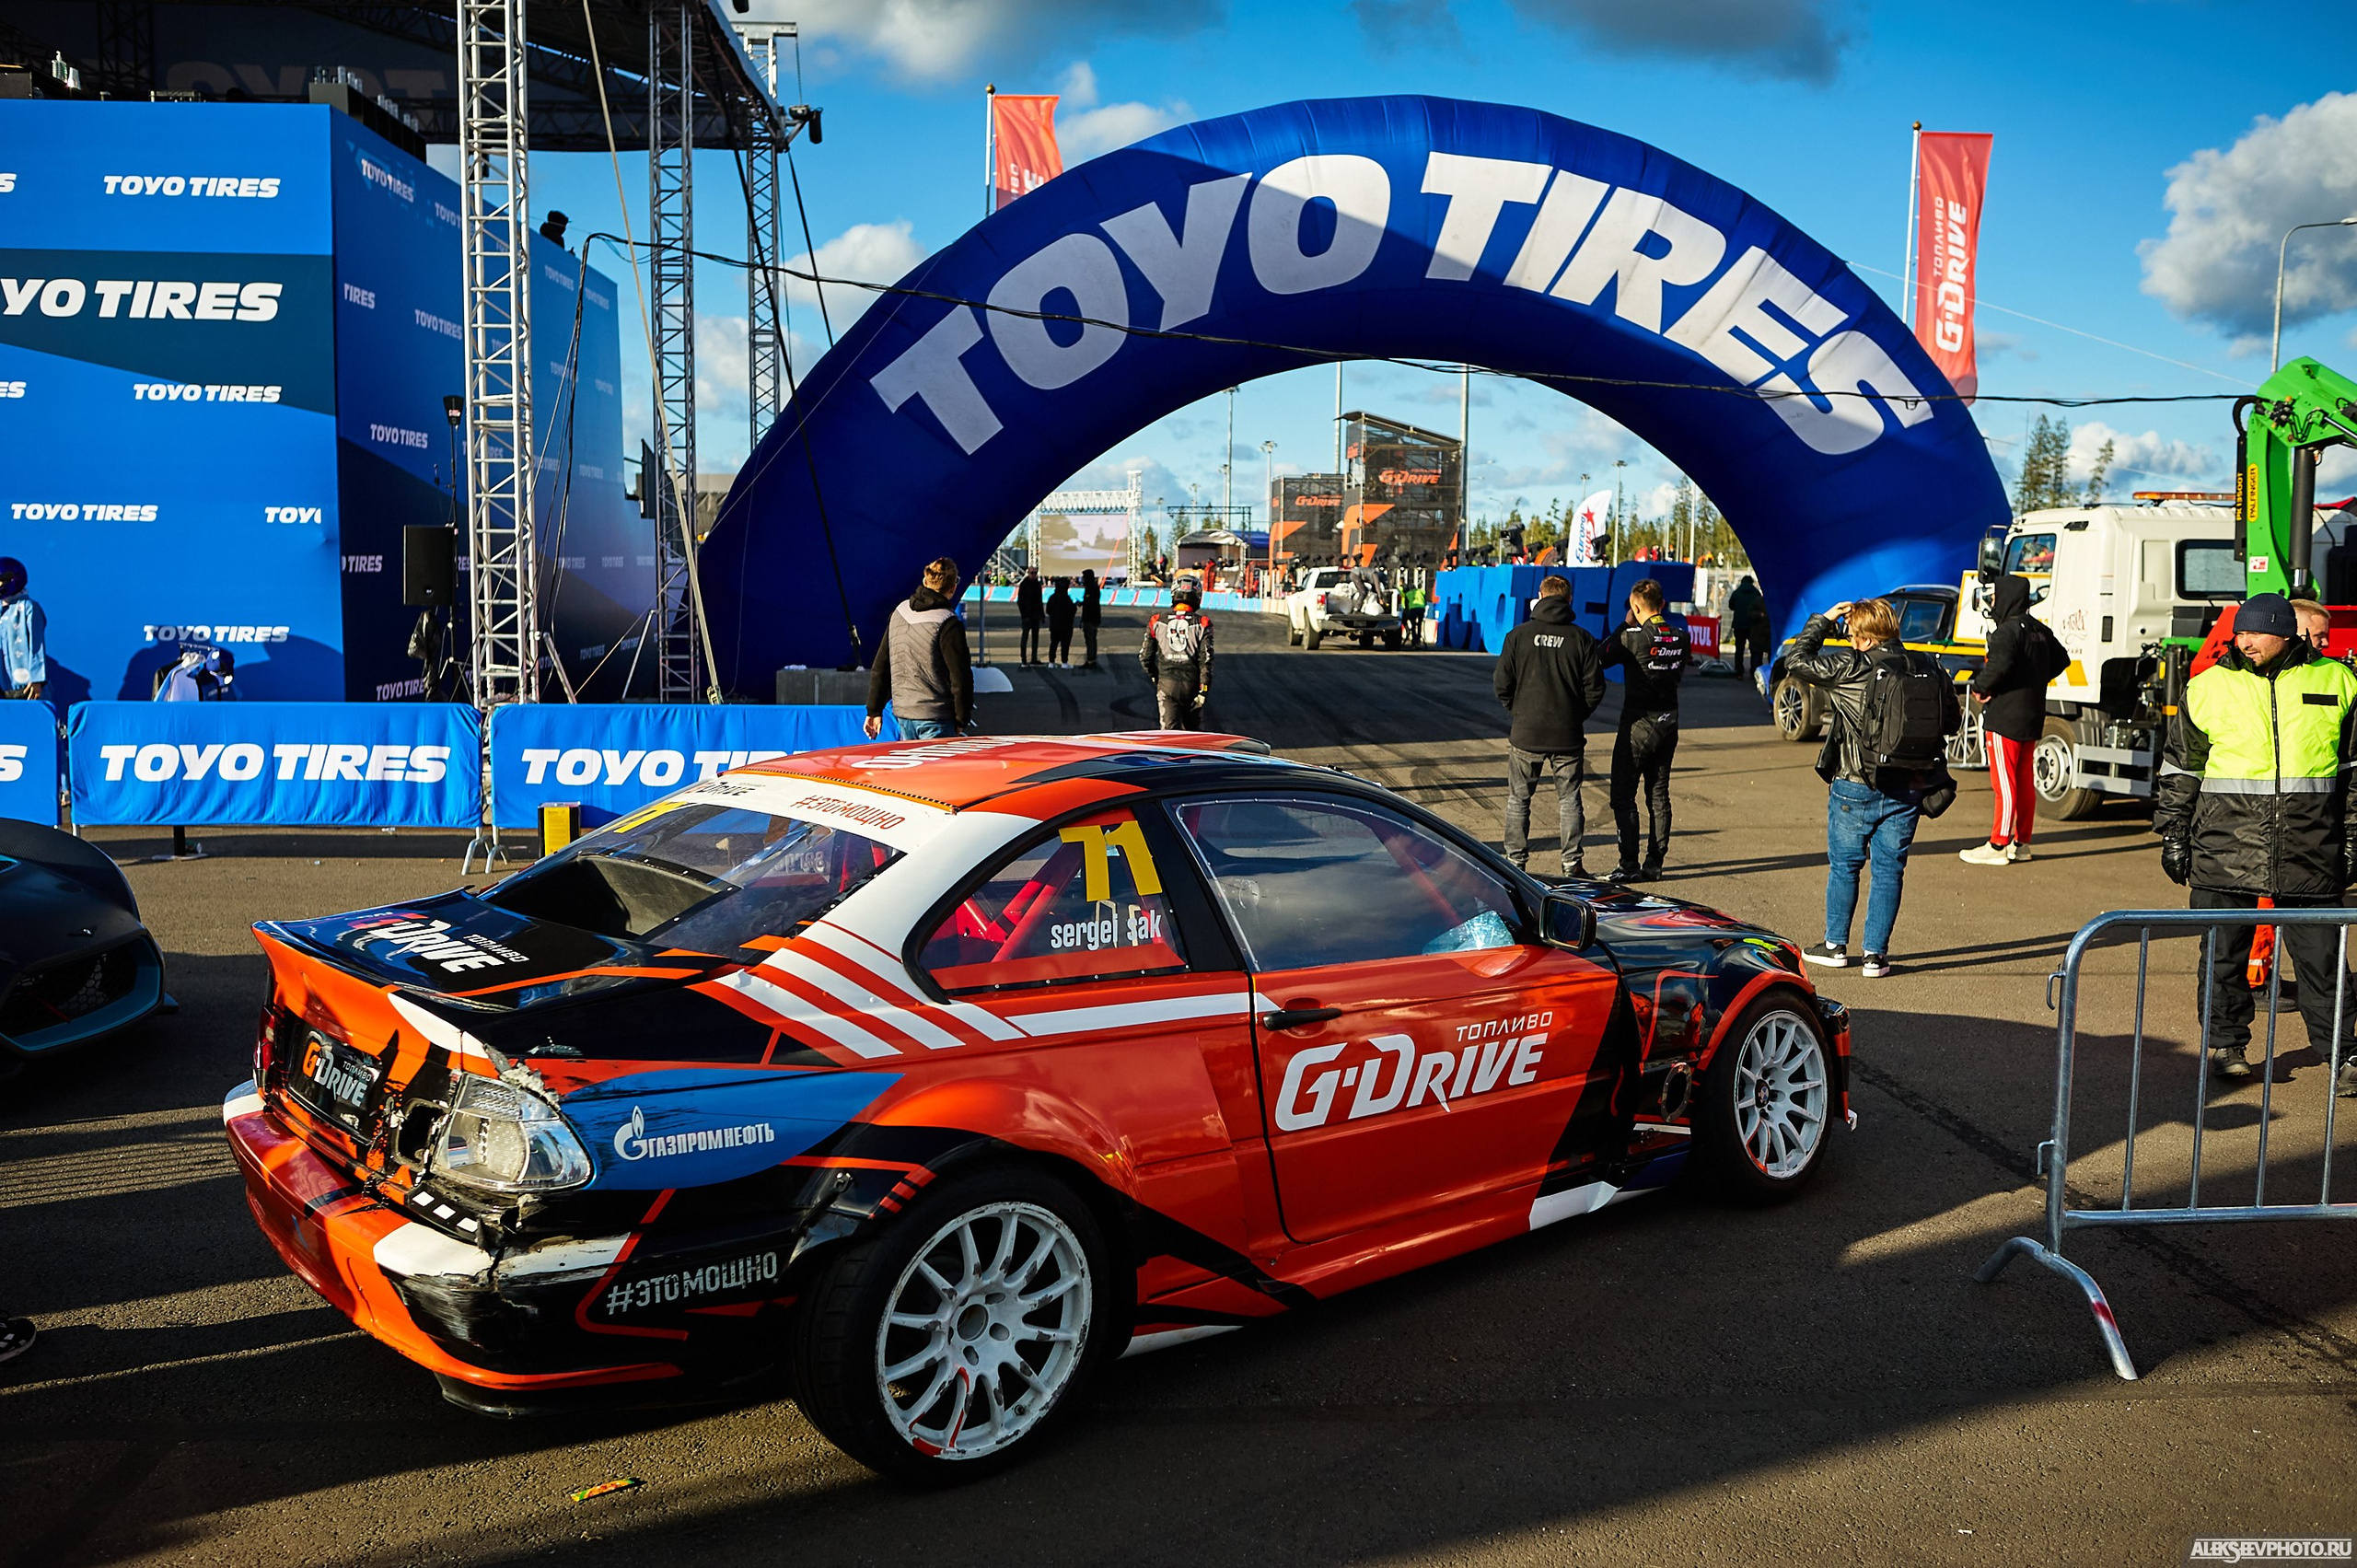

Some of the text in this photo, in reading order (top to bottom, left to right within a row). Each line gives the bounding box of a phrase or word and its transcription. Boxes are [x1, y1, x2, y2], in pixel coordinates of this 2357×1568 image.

[103, 175, 281, 199] TOYO TIRES
[361, 157, 414, 203] TOYO TIRES
[94, 281, 284, 321] TIRES
[869, 150, 1933, 455] TOYO TIRES
[414, 308, 463, 341] TOYO TIRES
[134, 382, 282, 404] TOYO TIRES
[370, 424, 429, 450] TOYO TIRES
[11, 503, 158, 522] TOYO TIRES
[348, 555, 383, 573] TIRES
[144, 625, 290, 643] TOYO TIRES
[1534, 634, 1564, 648] CREW
[377, 679, 424, 702] TOYO TIRE
[99, 743, 451, 784] TOYO TIRES
[521, 749, 687, 786] TOYO
[1058, 820, 1163, 902] 71
[1051, 909, 1162, 951] sergei sak
[1456, 1011, 1553, 1042] ТОПЛИВО
[343, 1061, 372, 1082] ТОПЛИВО
[648, 1122, 775, 1158] ГАЗПРОМНЕФТЬ
